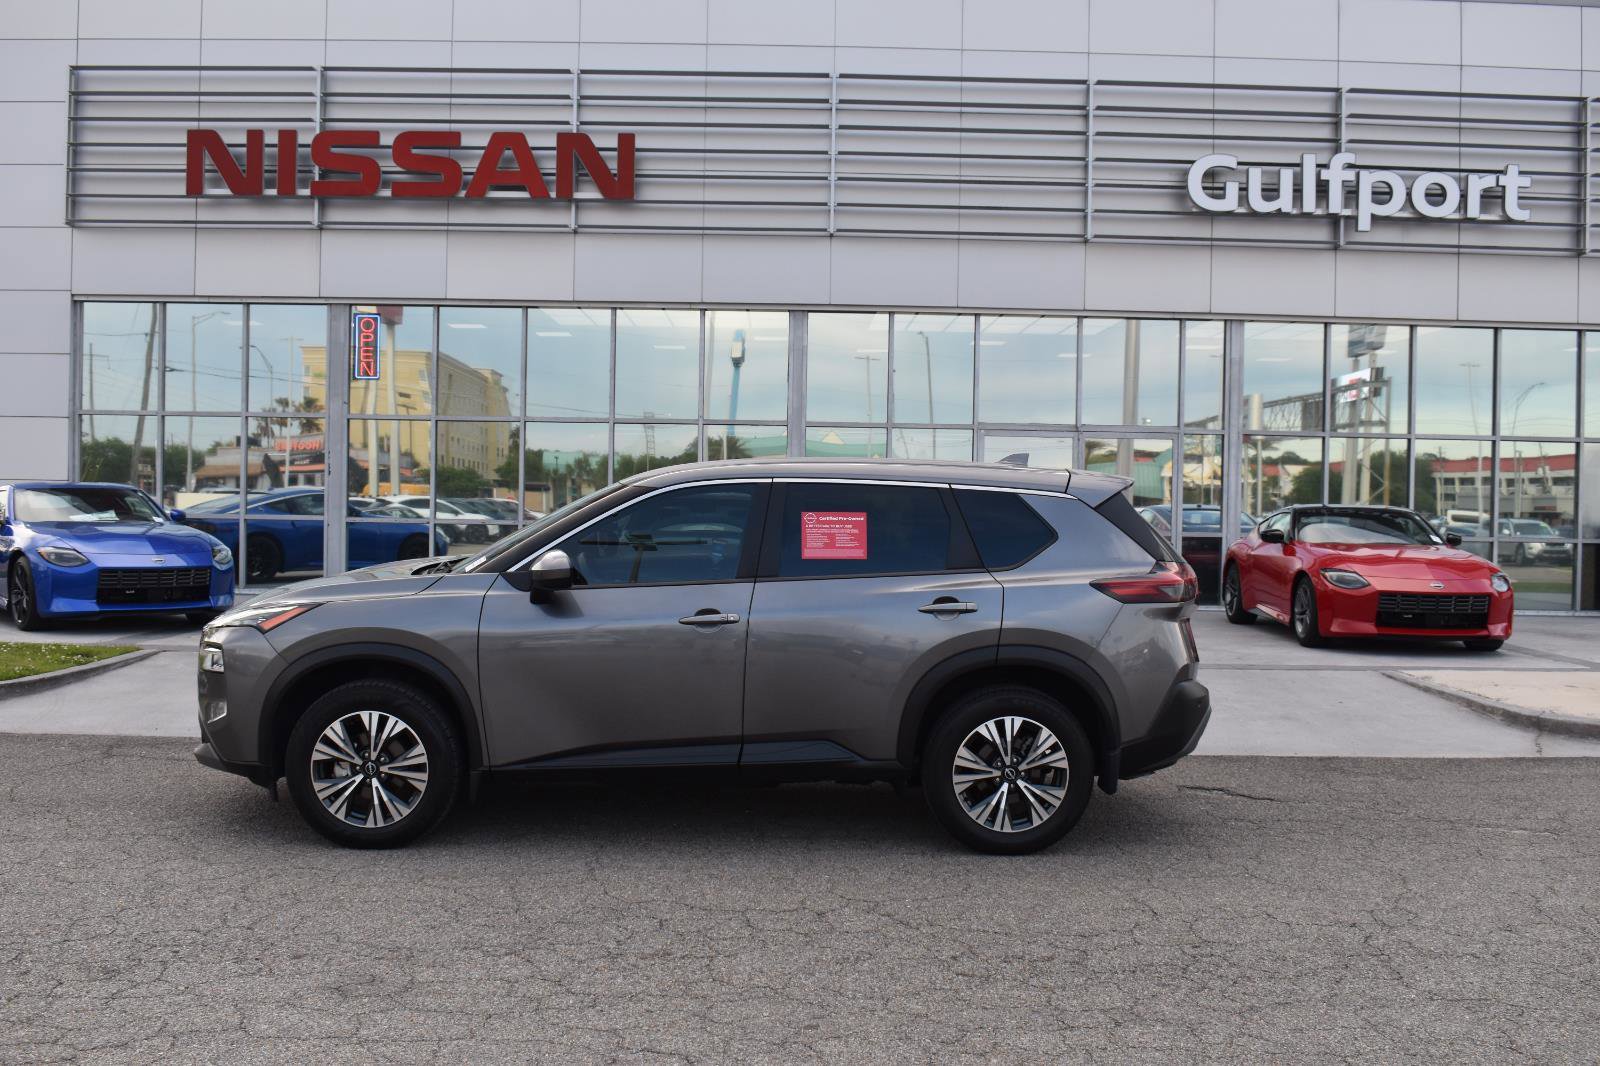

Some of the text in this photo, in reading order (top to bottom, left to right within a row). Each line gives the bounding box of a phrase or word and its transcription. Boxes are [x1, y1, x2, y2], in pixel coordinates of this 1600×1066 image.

[186, 129, 636, 199] NISSAN
[1187, 152, 1532, 232] Gulfport
[360, 317, 375, 376] OPEN
